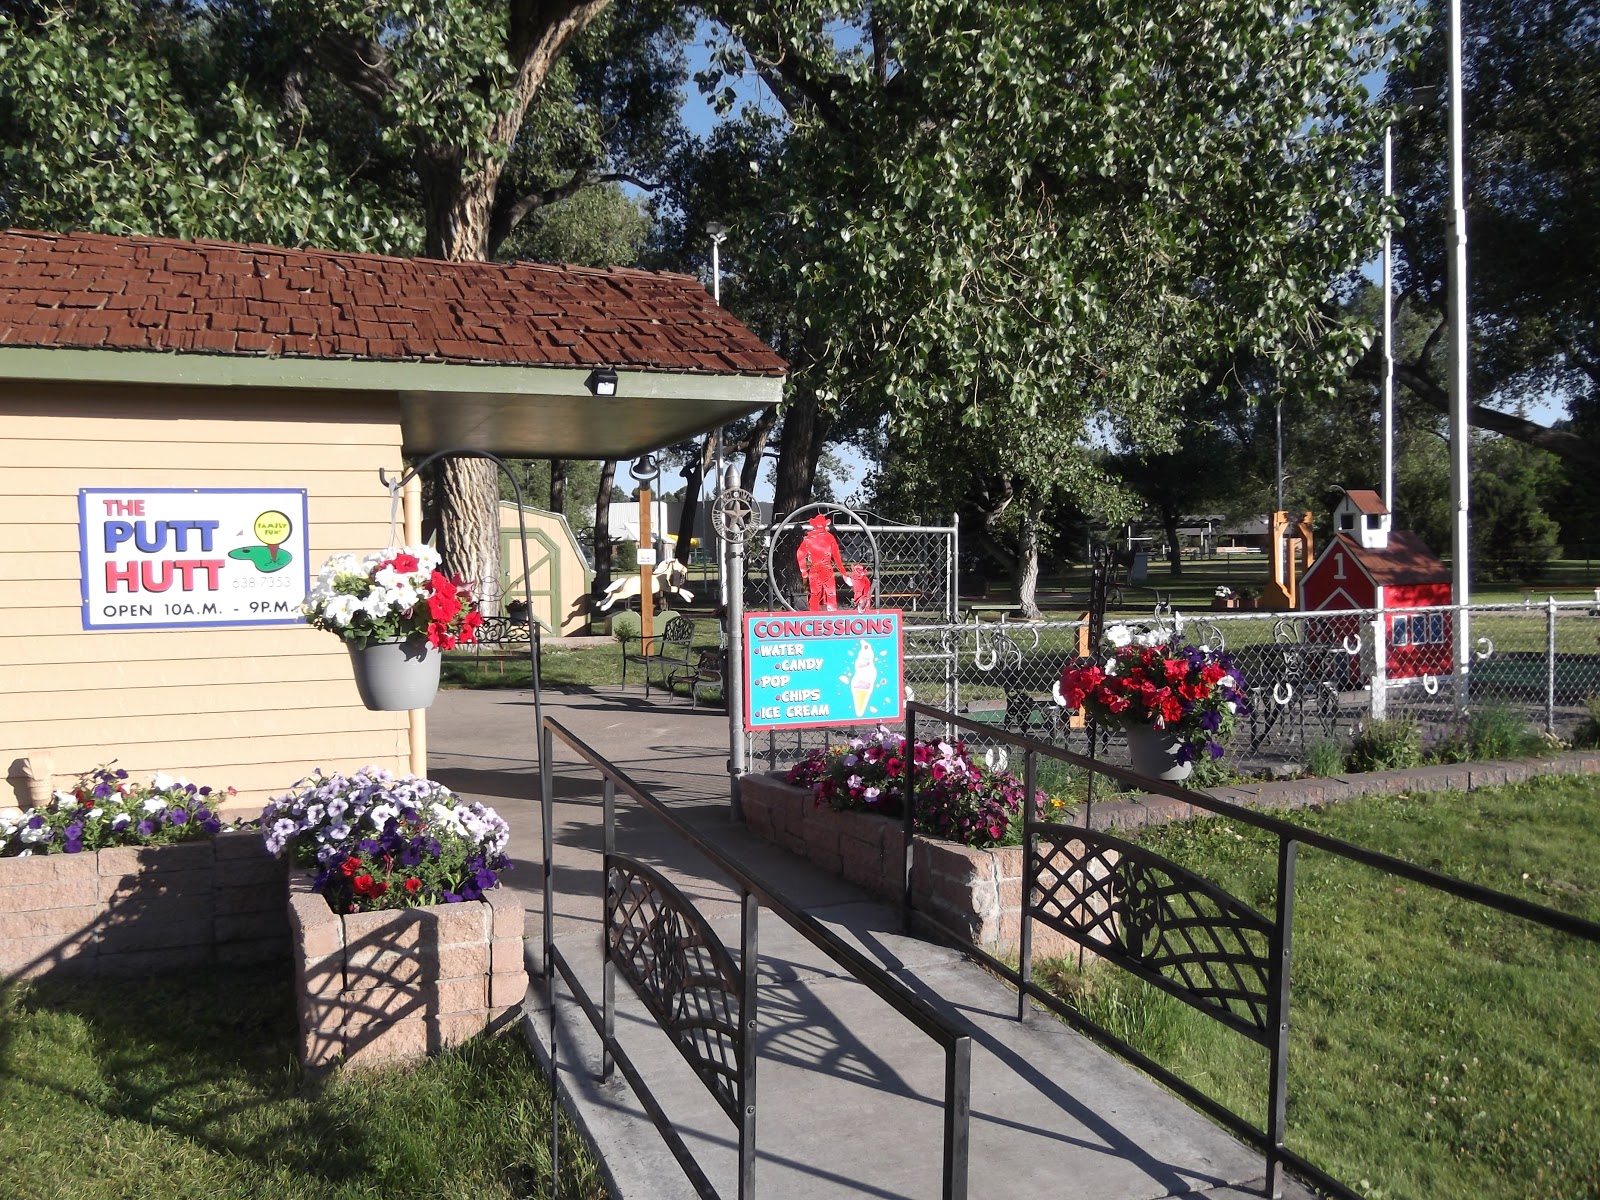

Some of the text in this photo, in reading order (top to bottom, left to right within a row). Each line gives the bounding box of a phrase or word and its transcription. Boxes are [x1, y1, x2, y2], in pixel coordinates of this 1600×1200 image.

[103, 499, 145, 516] THE
[104, 520, 219, 553] PUTT
[1333, 552, 1347, 580] 1
[105, 559, 225, 593] HUTT
[232, 576, 291, 589] 638-7353
[103, 605, 153, 617] OPEN
[164, 603, 222, 616] 10A.M.
[754, 618, 894, 638] CONCESSIONS
[760, 643, 804, 657] WATER
[781, 658, 824, 672] CANDY
[760, 675, 790, 688] POP
[781, 689, 821, 703] CHIPS
[760, 704, 829, 719] ICE CREAM
